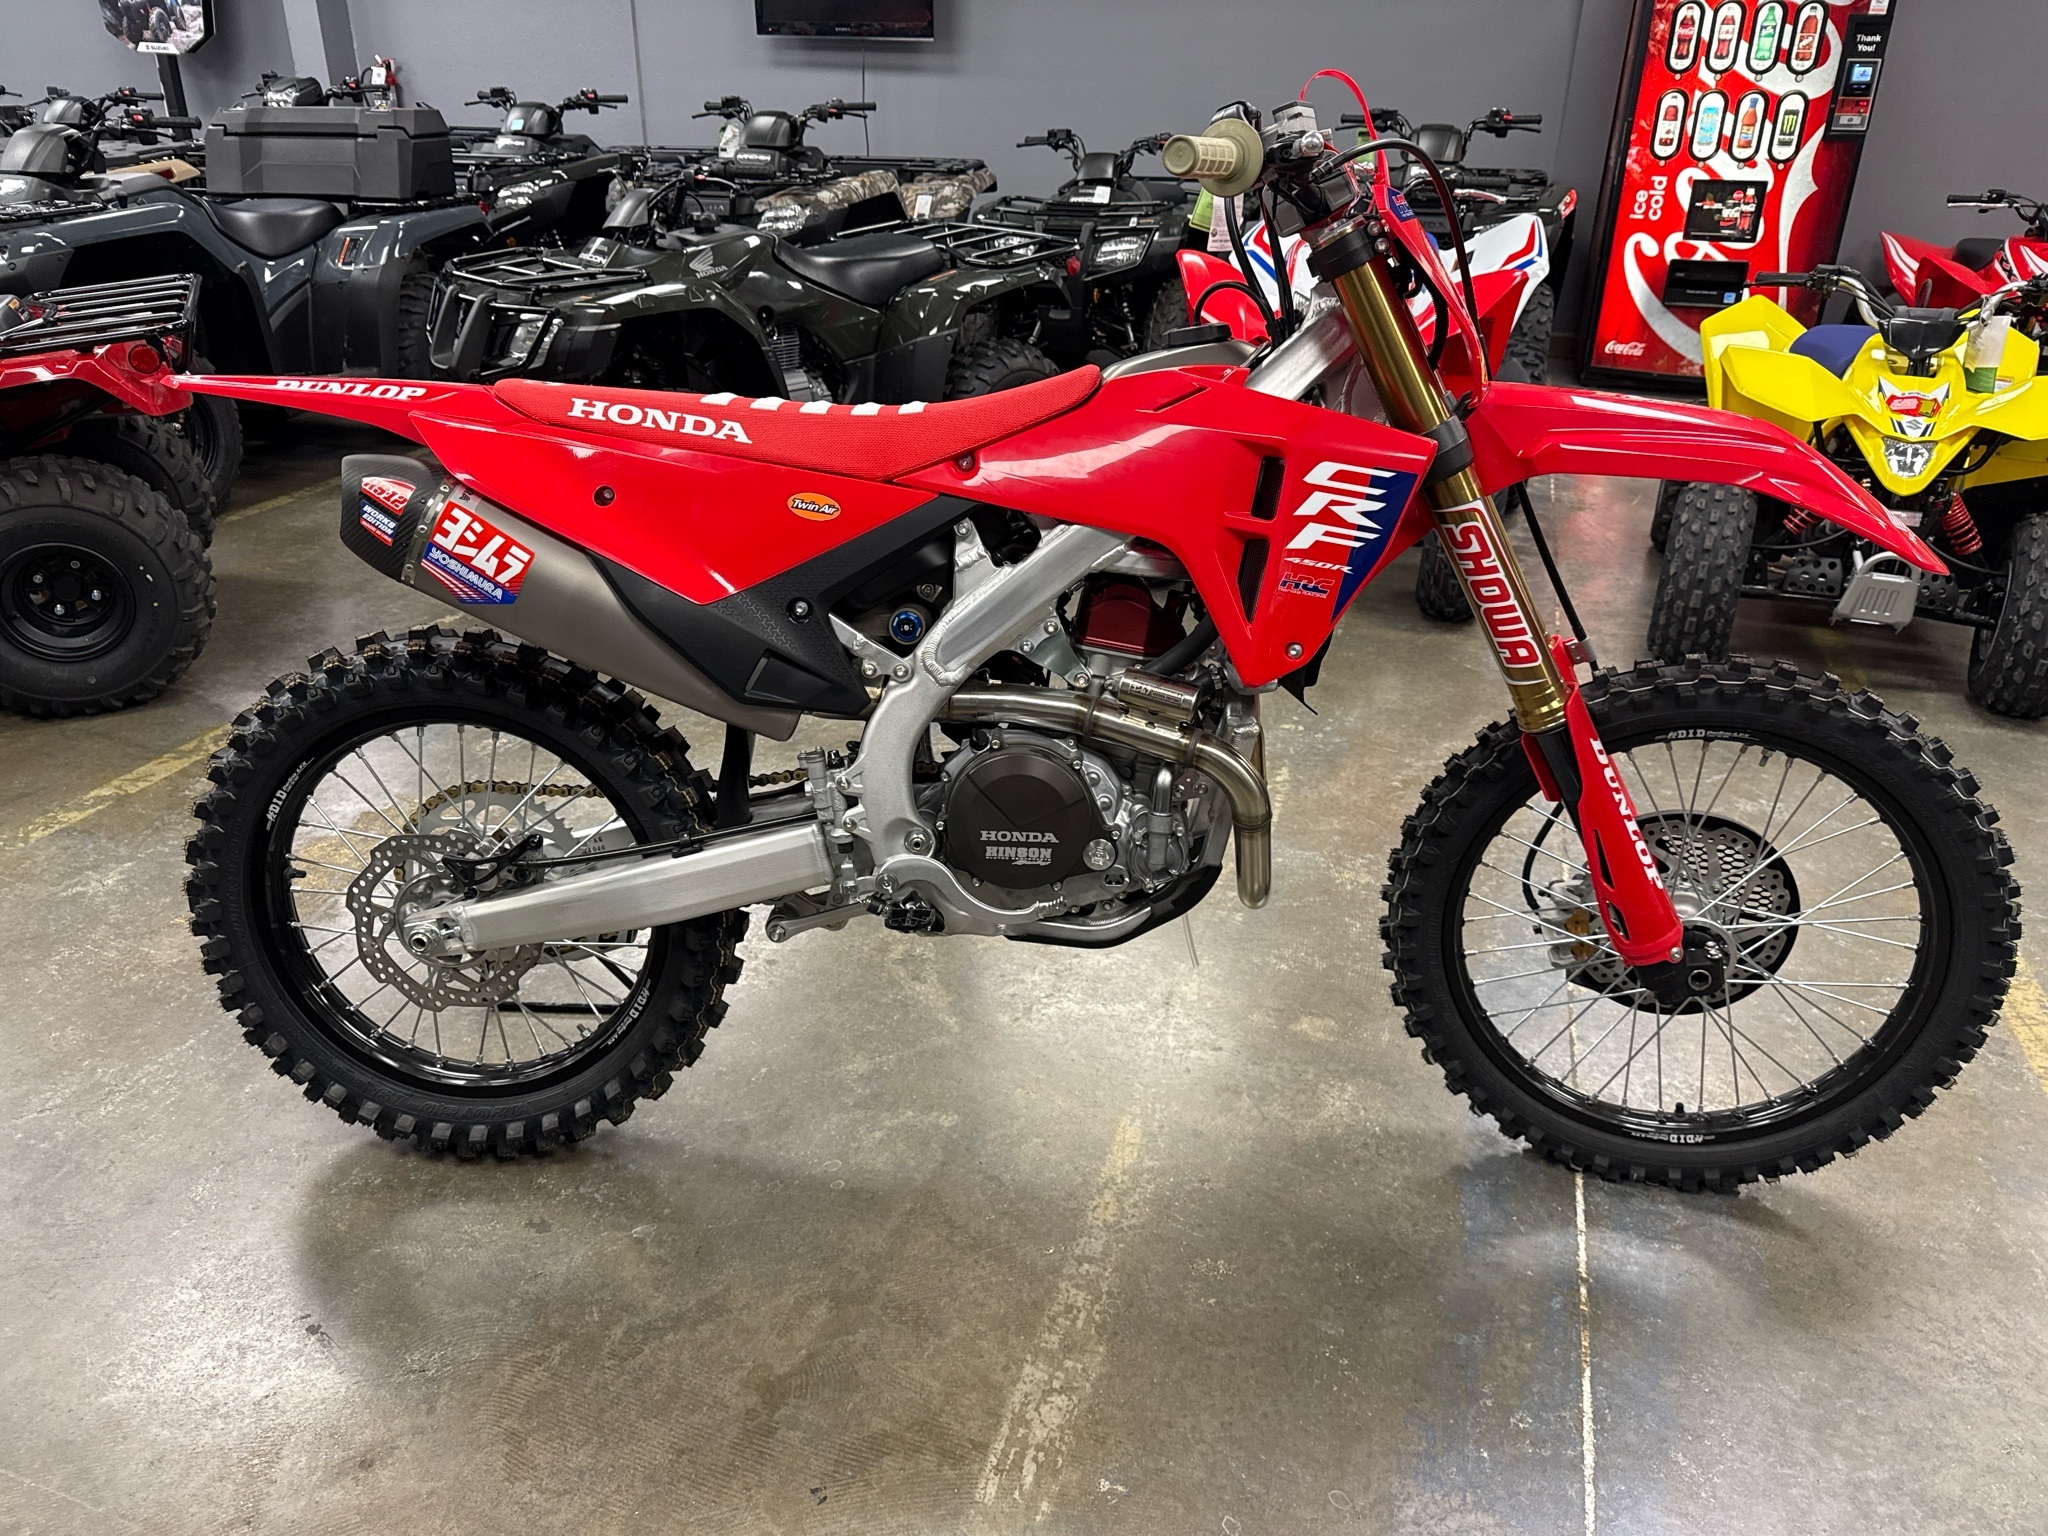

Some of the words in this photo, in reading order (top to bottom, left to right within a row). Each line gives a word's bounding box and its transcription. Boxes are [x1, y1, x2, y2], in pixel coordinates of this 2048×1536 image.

[1856, 34, 1881, 42] Thank
[1857, 44, 1876, 52] You!
[1629, 190, 1649, 219] ice
[1648, 176, 1668, 221] cold
[695, 265, 729, 279] HONDA
[275, 379, 427, 401] DUNLOP
[567, 398, 753, 444] HONDA
[363, 505, 397, 529] WORKS
[793, 499, 819, 511] Twin
[819, 504, 838, 515] Air
[1285, 461, 1398, 550] CRF
[362, 513, 394, 535] EDITION
[433, 507, 531, 584] ヨシムラ
[428, 547, 503, 601] YOSHIMURA
[1284, 557, 1354, 575] 450R
[1279, 572, 1336, 596] HRC
[1444, 521, 1542, 668] SHOWA
[1590, 738, 1664, 890] DUNLOP
[980, 830, 1060, 843] HONDA
[985, 846, 1052, 859] HINSON
